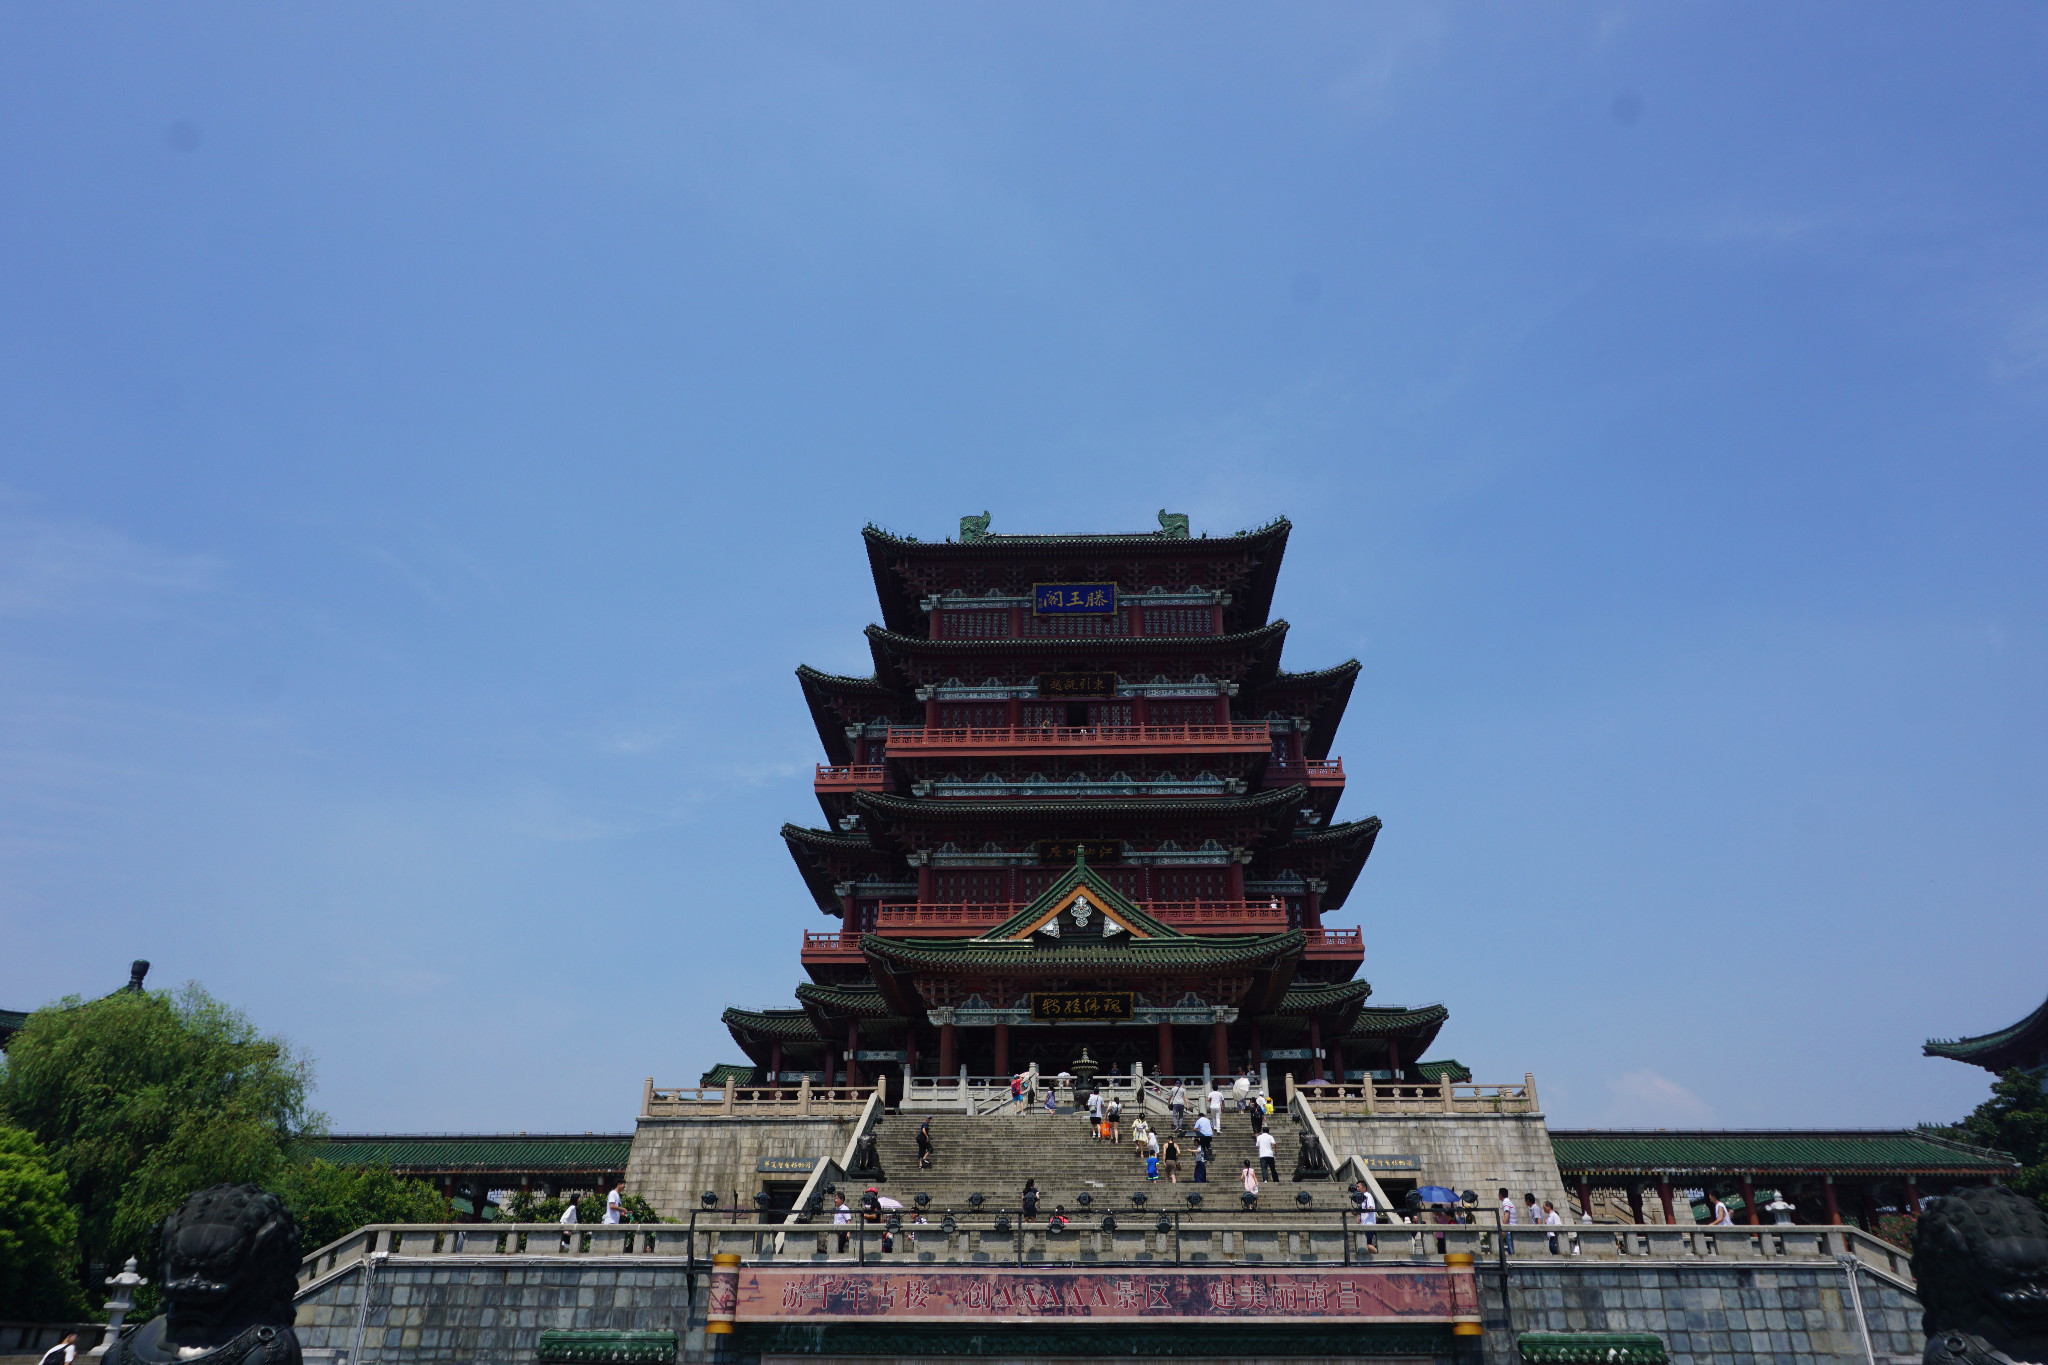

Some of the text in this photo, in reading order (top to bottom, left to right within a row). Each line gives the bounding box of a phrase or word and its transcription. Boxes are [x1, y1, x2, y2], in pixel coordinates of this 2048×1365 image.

[782, 1280, 1361, 1310] 游千年古楼 创AAAAA景区 建美丽南昌
